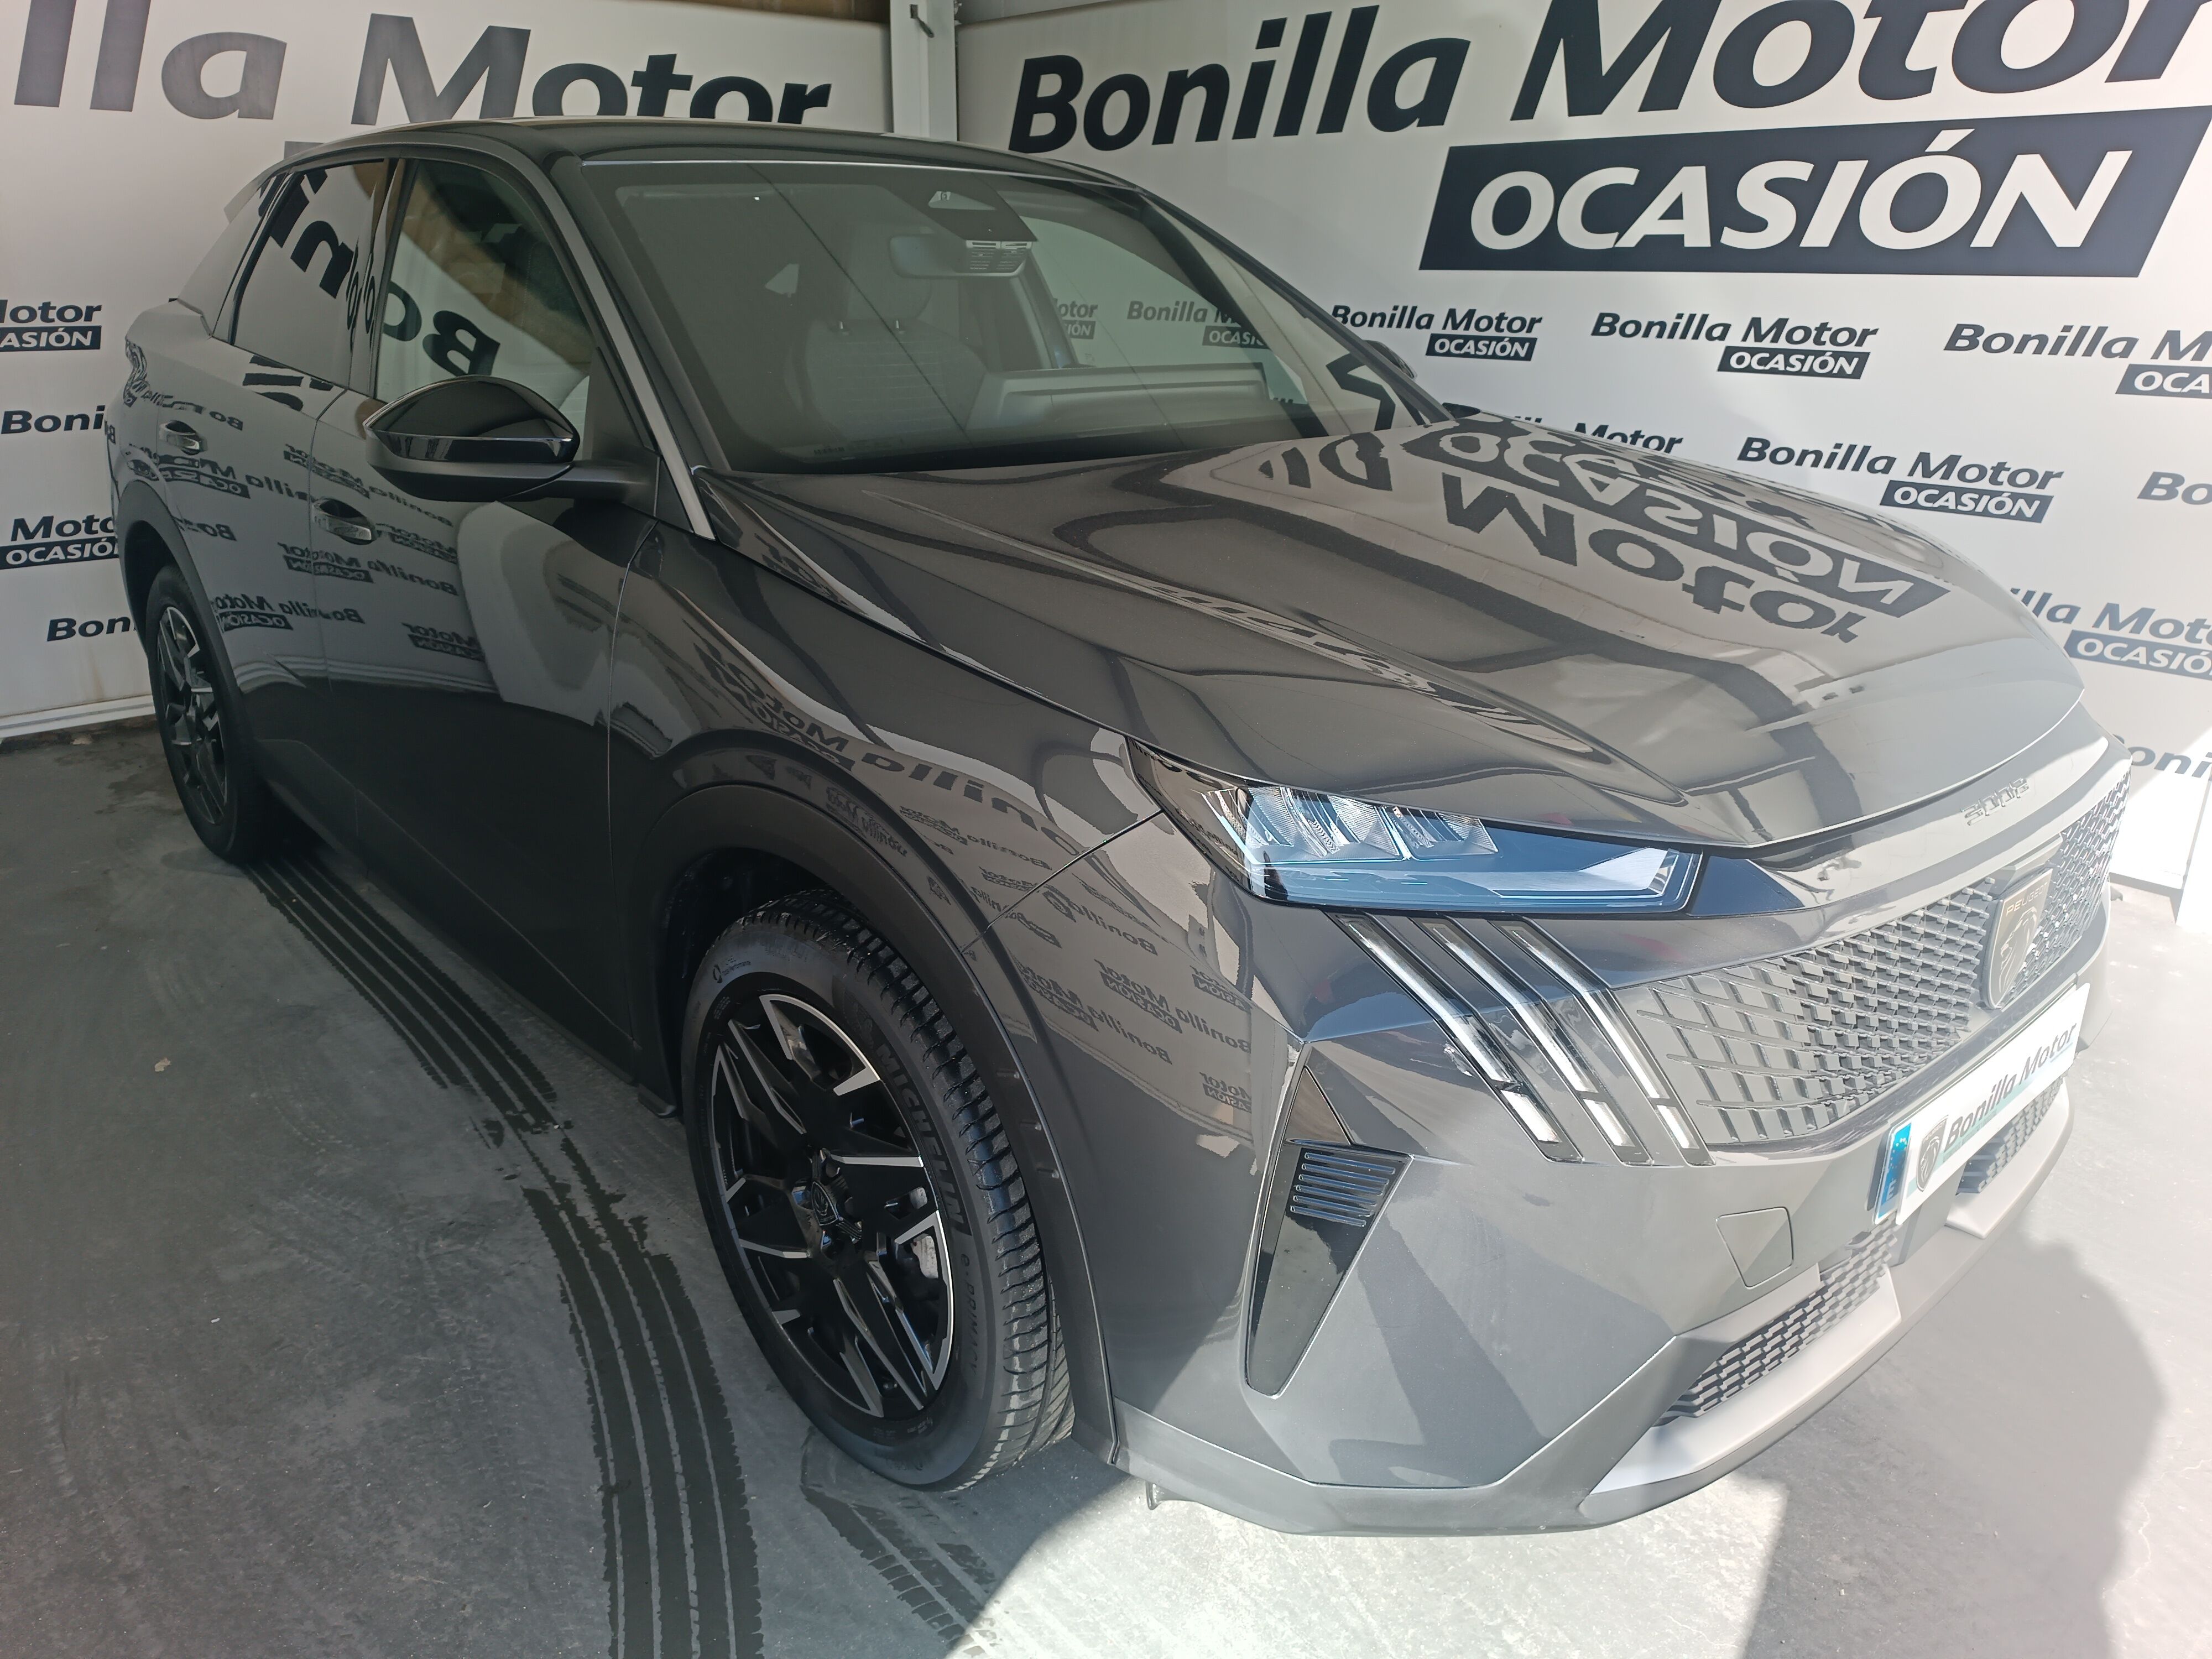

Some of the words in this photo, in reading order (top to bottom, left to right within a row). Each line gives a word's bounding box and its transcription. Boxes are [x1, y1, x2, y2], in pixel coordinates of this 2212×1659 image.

[351, 13, 832, 126] Motor
[1008, 5, 1470, 153] Bonilla
[1510, 0, 2212, 121] Motor
[1470, 128, 2133, 250] OCASIÓN
[1053, 298, 1098, 319] otor
[1127, 300, 1208, 323] Bonilla
[1331, 305, 1434, 331] Bonilla
[1442, 308, 1542, 334] Motor
[1590, 312, 1732, 342] Bonilla
[1740, 316, 1879, 347] Motor
[1944, 323, 2140, 359] Bonilla
[1434, 336, 1530, 358] OCASIÓN
[1729, 351, 1859, 375] OCASIÓN
[1, 405, 105, 435] Boni
[1737, 436, 1897, 474] Bonilla
[1908, 451, 2064, 490] Motor
[1893, 487, 2041, 519] OCASIÓN
[47, 616, 136, 642] Bon
[2092, 602, 2212, 644] Mot
[1943, 1073, 2017, 1152] Bonilla
[2019, 1022, 2077, 1086] Motor
